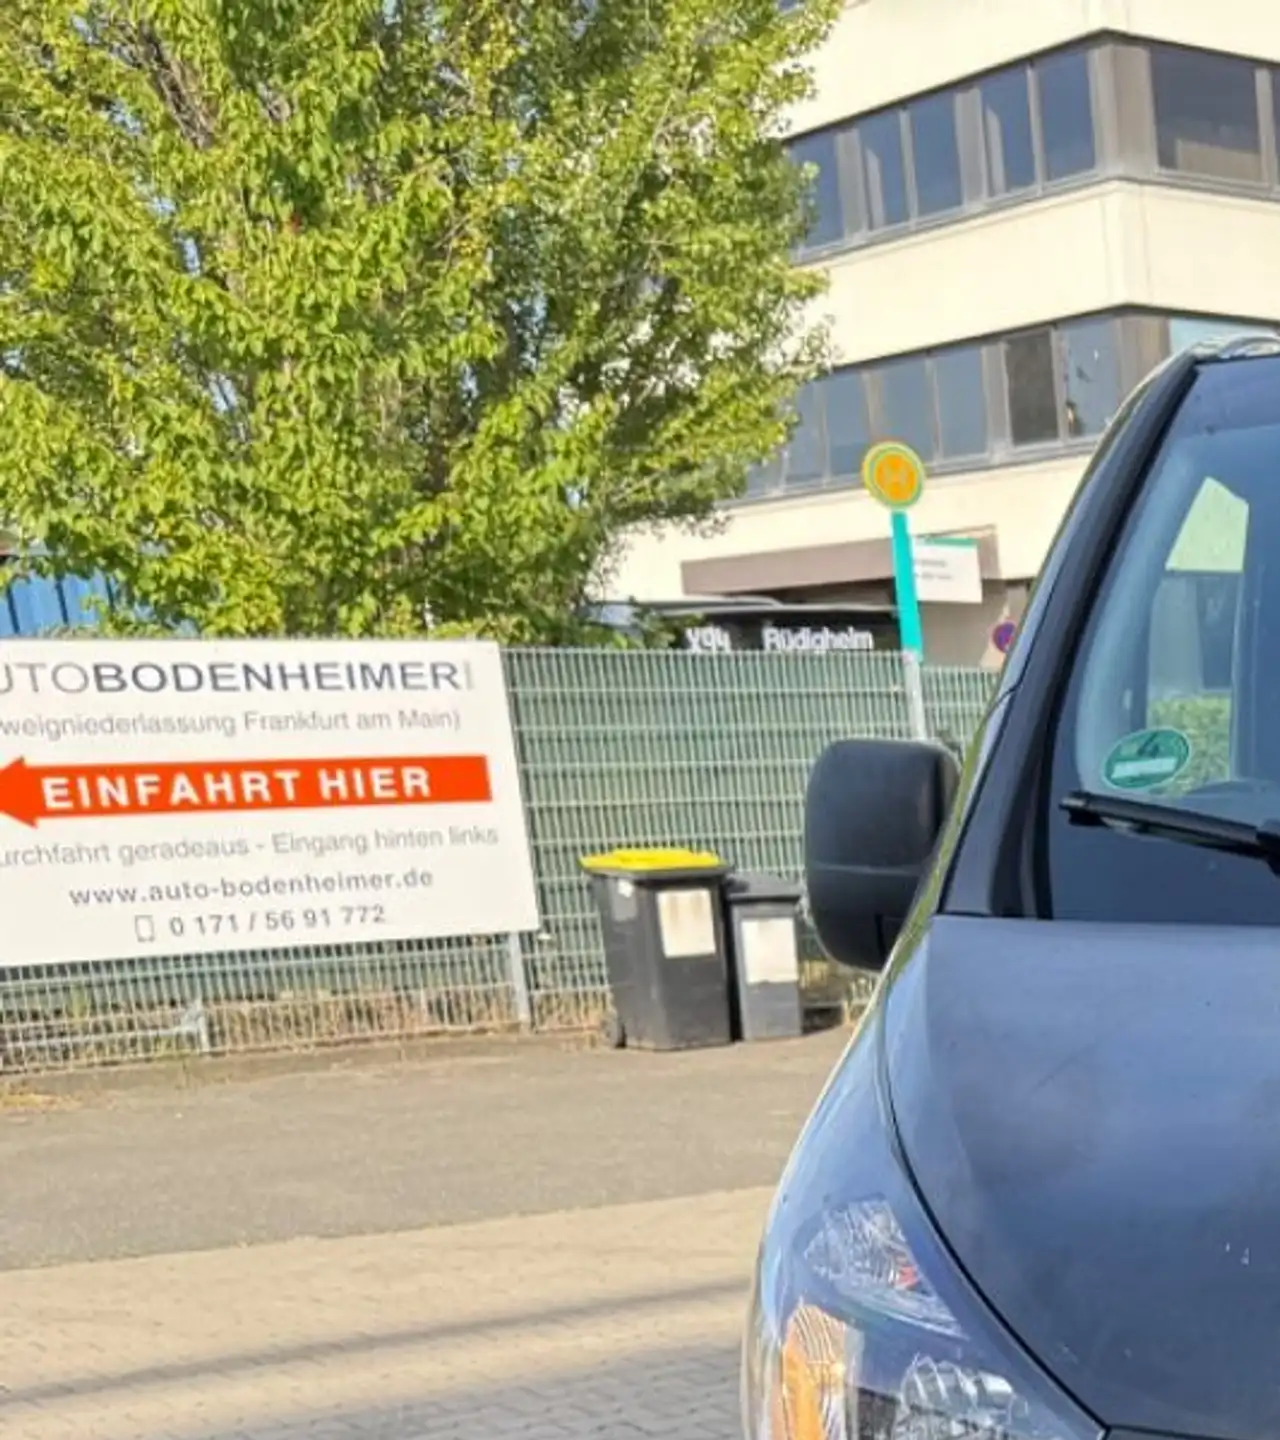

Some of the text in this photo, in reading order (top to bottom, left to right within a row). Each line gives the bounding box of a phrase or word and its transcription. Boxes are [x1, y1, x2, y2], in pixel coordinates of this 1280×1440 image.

[243, 709, 350, 732] Frankfurt
[356, 713, 392, 731] am
[398, 708, 461, 732] Main)
[41, 765, 431, 810] EINFAHRT HIER
[118, 837, 250, 867] geradeaus
[272, 832, 368, 858] Eingang
[373, 828, 443, 849] hinten
[448, 825, 498, 846] links
[69, 868, 433, 907] www.auto-bodenheimer.de
[169, 903, 386, 937] 0 171 / 56 91 772
